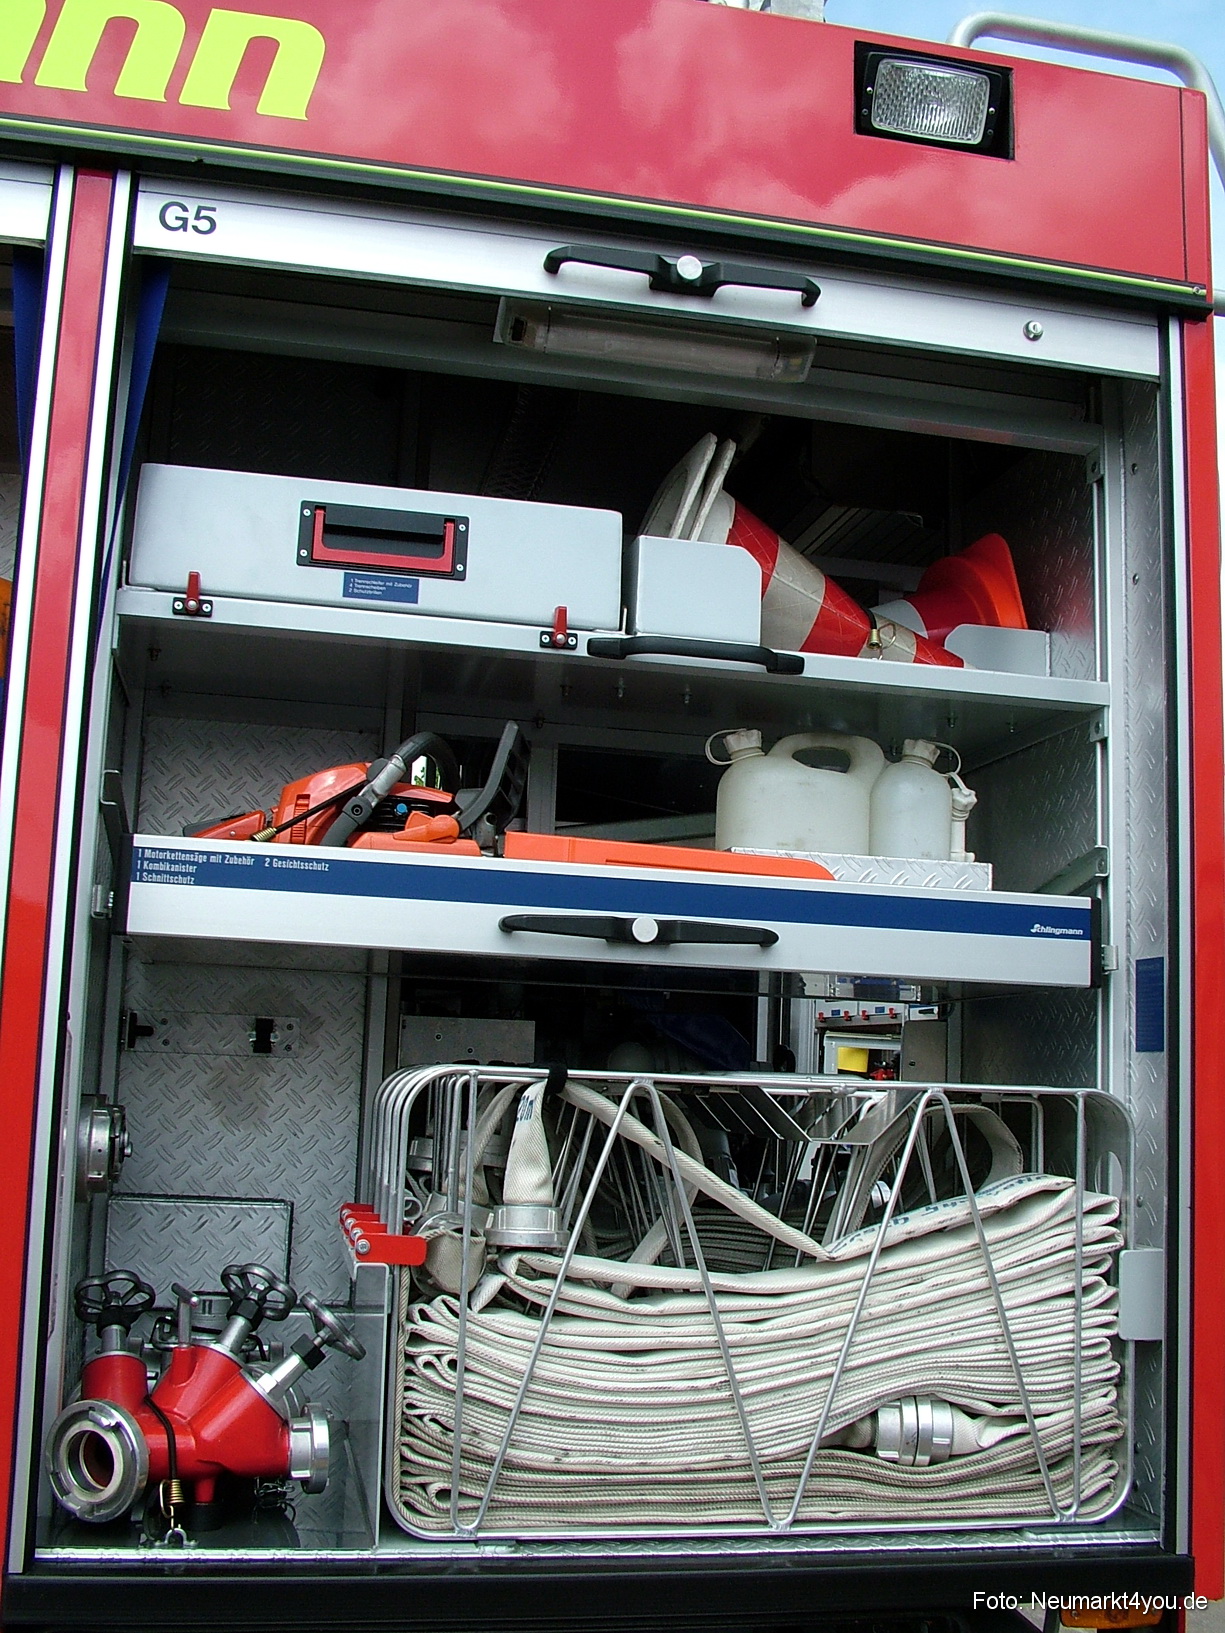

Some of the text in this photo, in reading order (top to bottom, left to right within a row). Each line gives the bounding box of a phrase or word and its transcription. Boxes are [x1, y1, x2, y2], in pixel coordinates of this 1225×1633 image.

[158, 201, 217, 235] G5
[137, 860, 198, 874] 1 Kombikanister
[138, 848, 330, 872] 1 Motorkettensäge mit Zubehör 2 Gesichtsschutz
[136, 871, 195, 885] 1 Schnittschutz
[1030, 923, 1084, 936] Schlingmann
